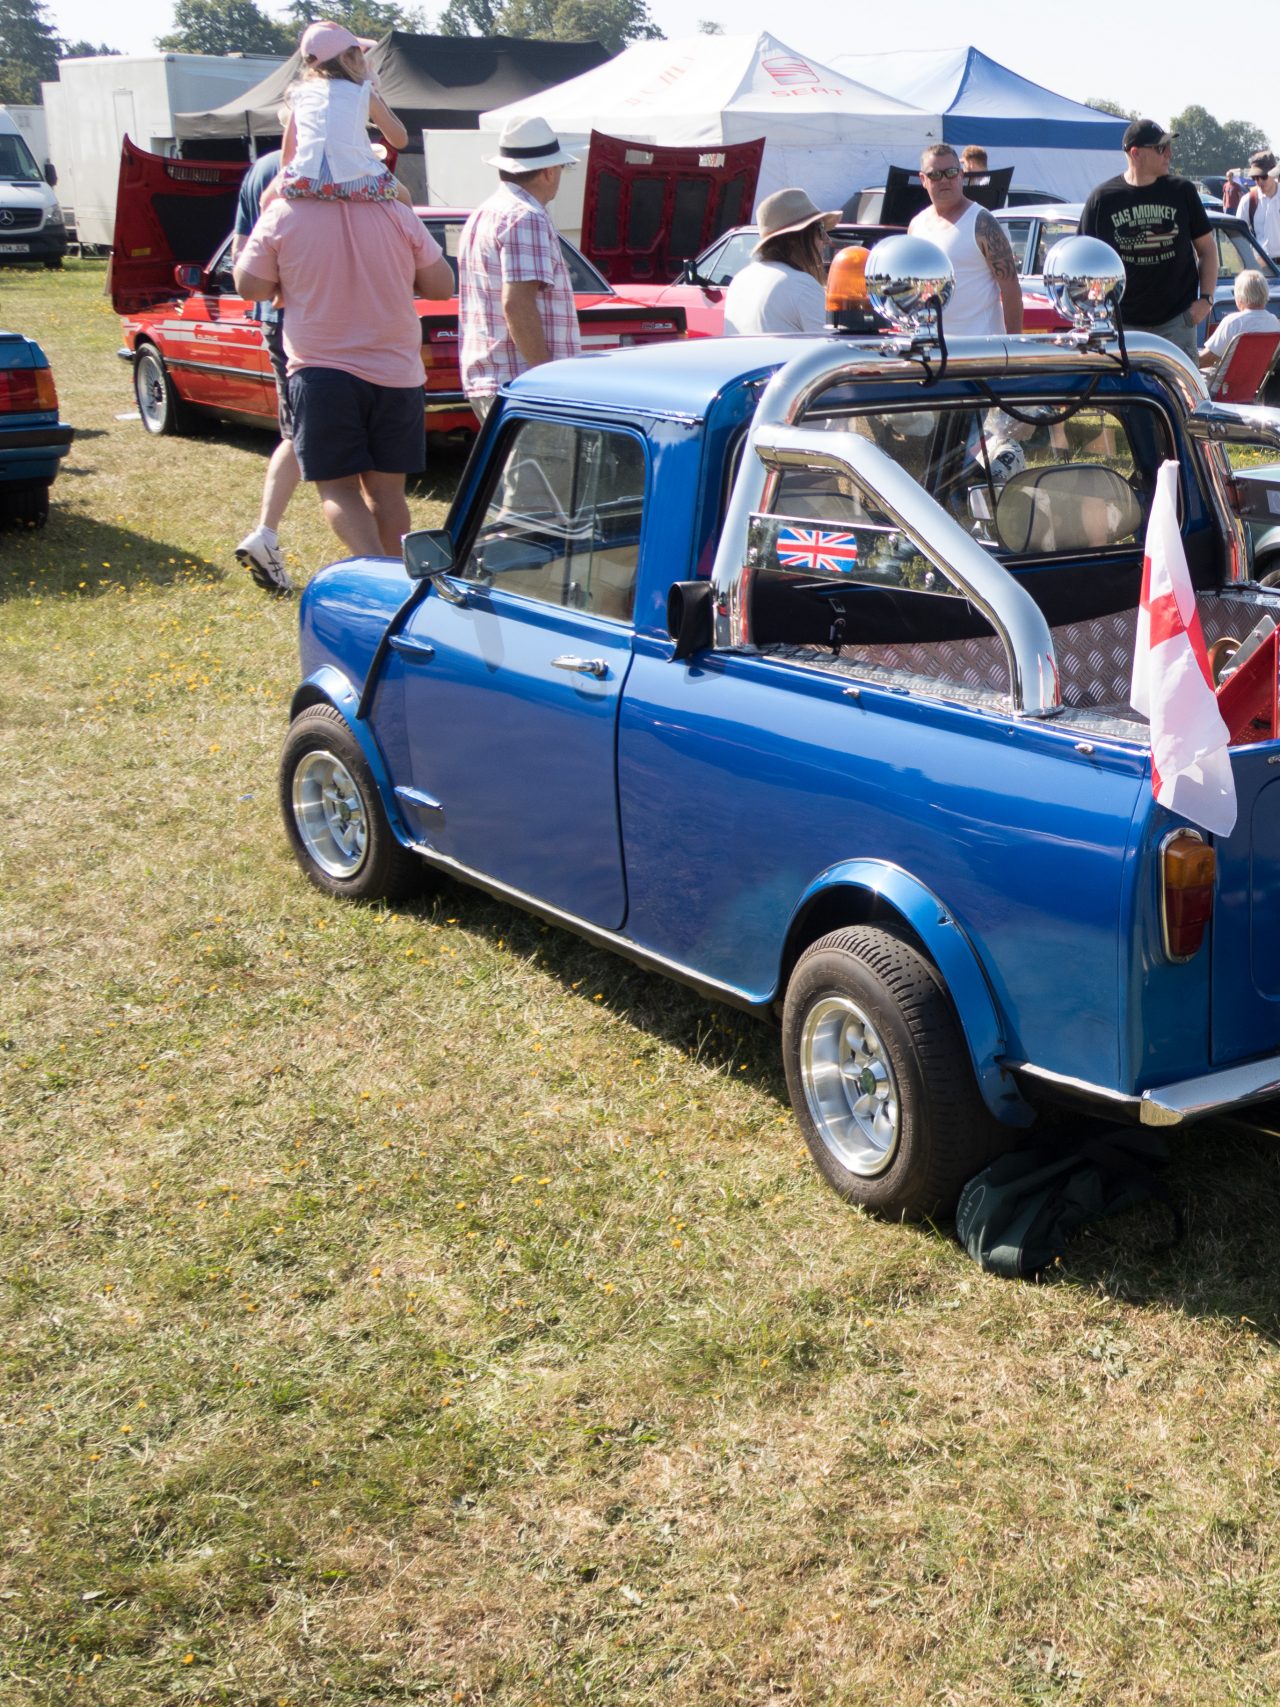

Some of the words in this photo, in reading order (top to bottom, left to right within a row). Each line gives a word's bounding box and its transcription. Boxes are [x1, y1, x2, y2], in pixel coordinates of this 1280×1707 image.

[771, 86, 844, 98] SEAT
[1111, 208, 1131, 227] GAS
[1131, 204, 1177, 221] MONKEY
